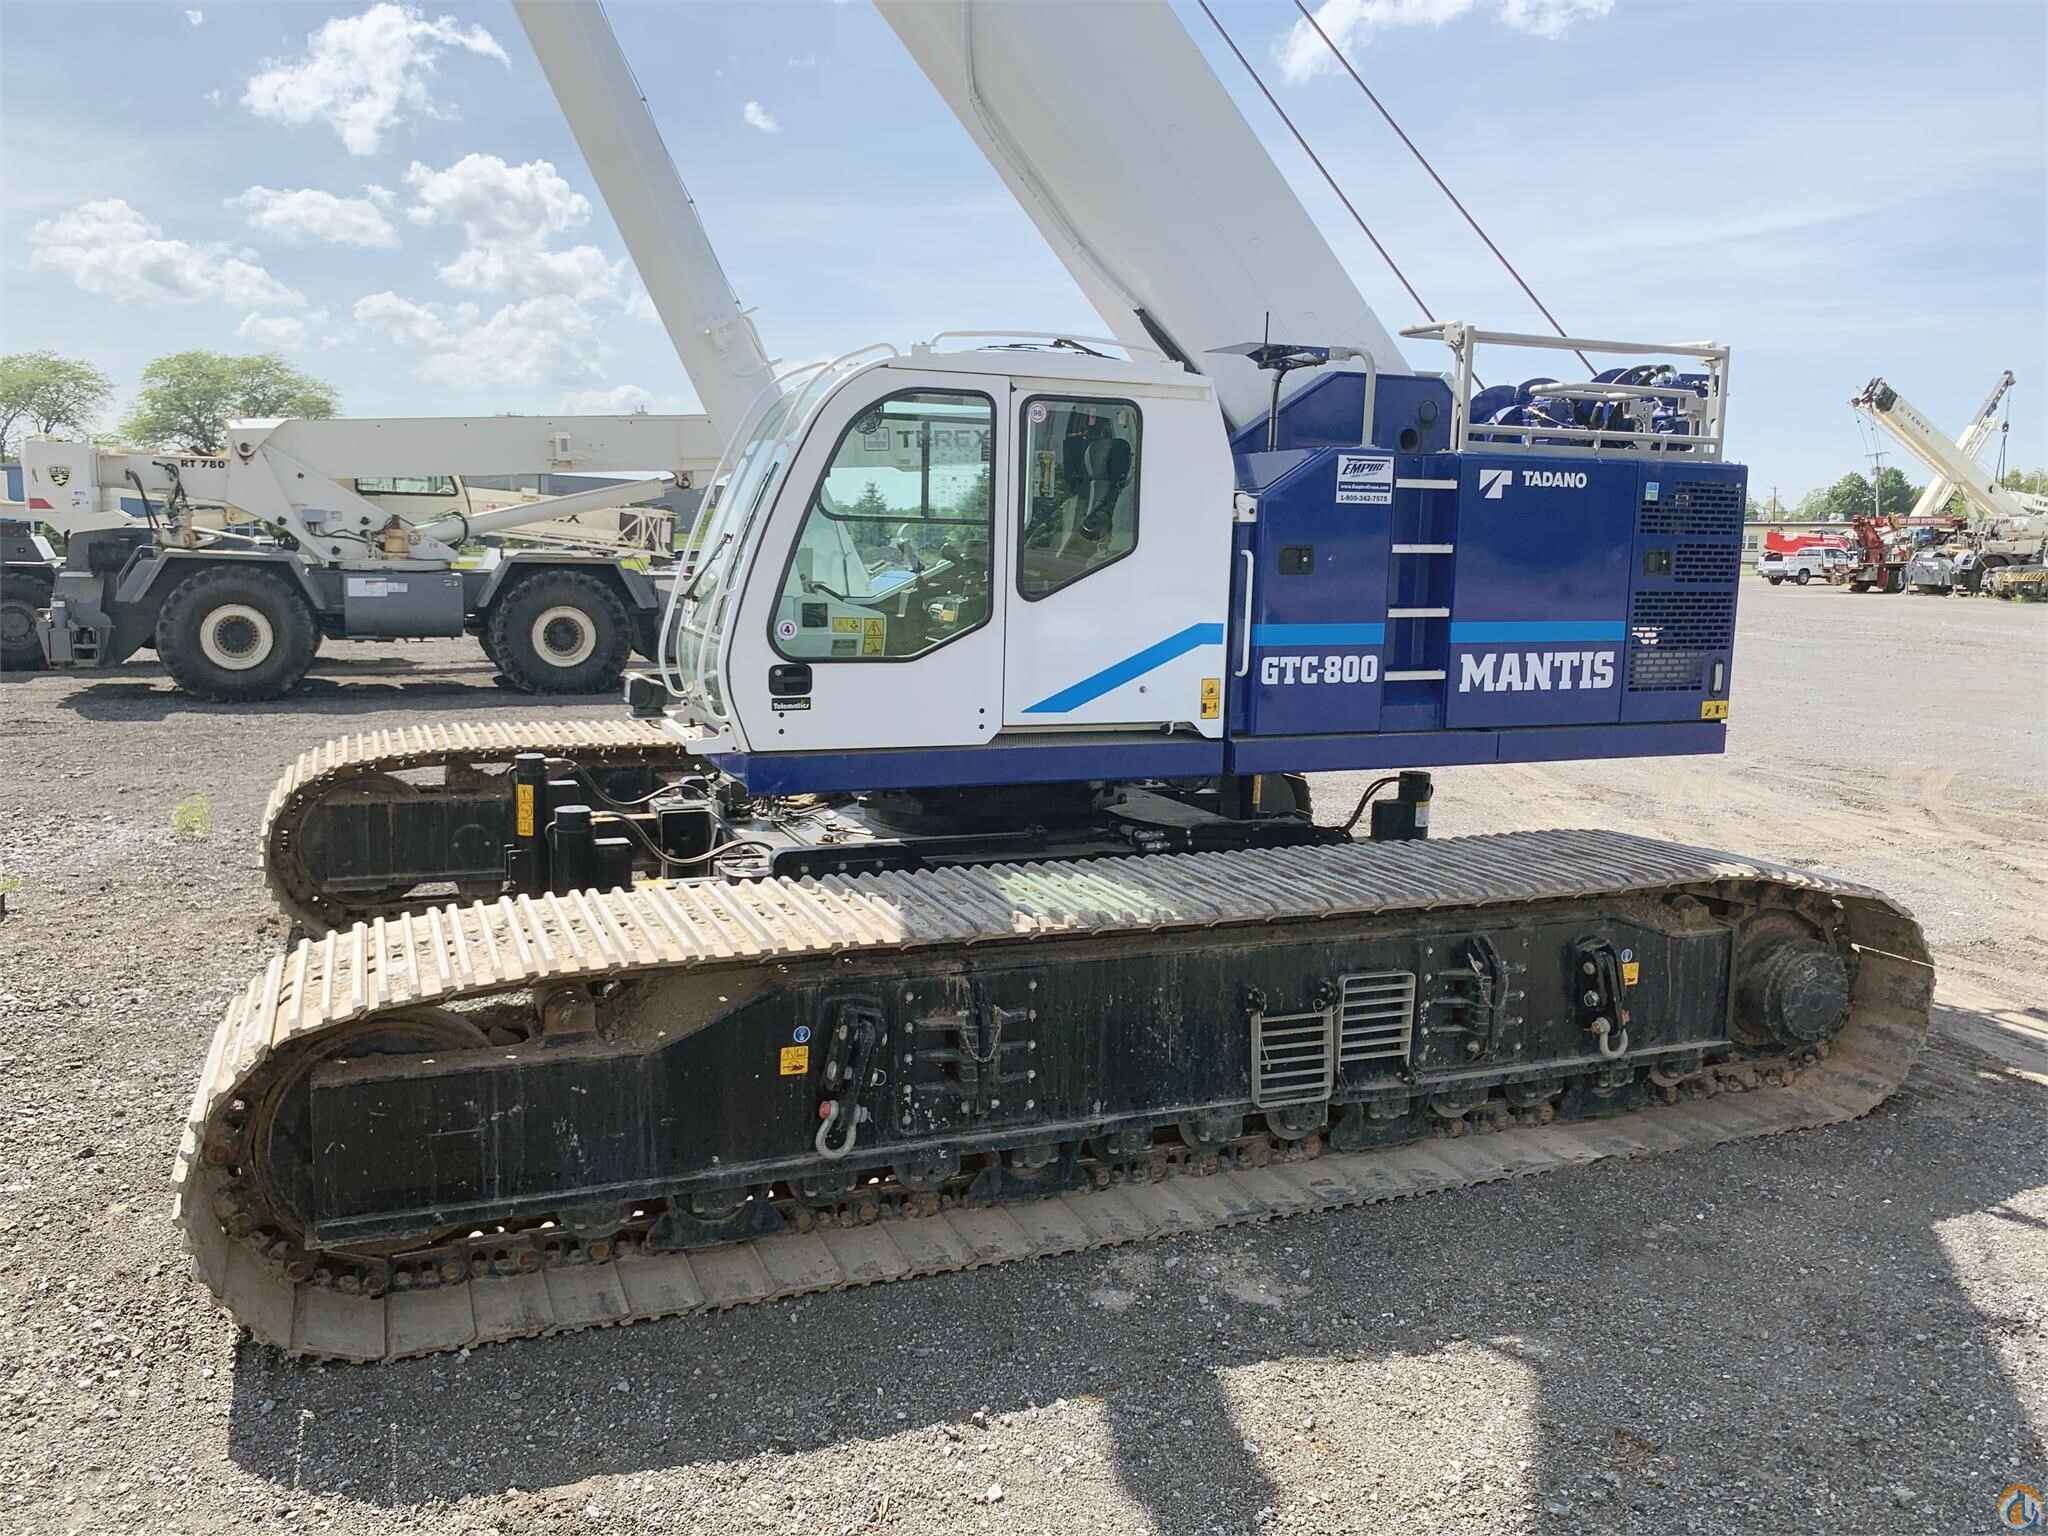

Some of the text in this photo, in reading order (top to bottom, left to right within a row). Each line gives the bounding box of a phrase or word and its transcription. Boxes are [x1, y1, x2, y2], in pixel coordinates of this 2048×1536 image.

[181, 459, 225, 469] RT 780
[1522, 470, 1588, 489] TADANO
[1261, 654, 1379, 685] GTC-800
[1458, 651, 1615, 692] MANTIS
[773, 702, 810, 710] Telematics
